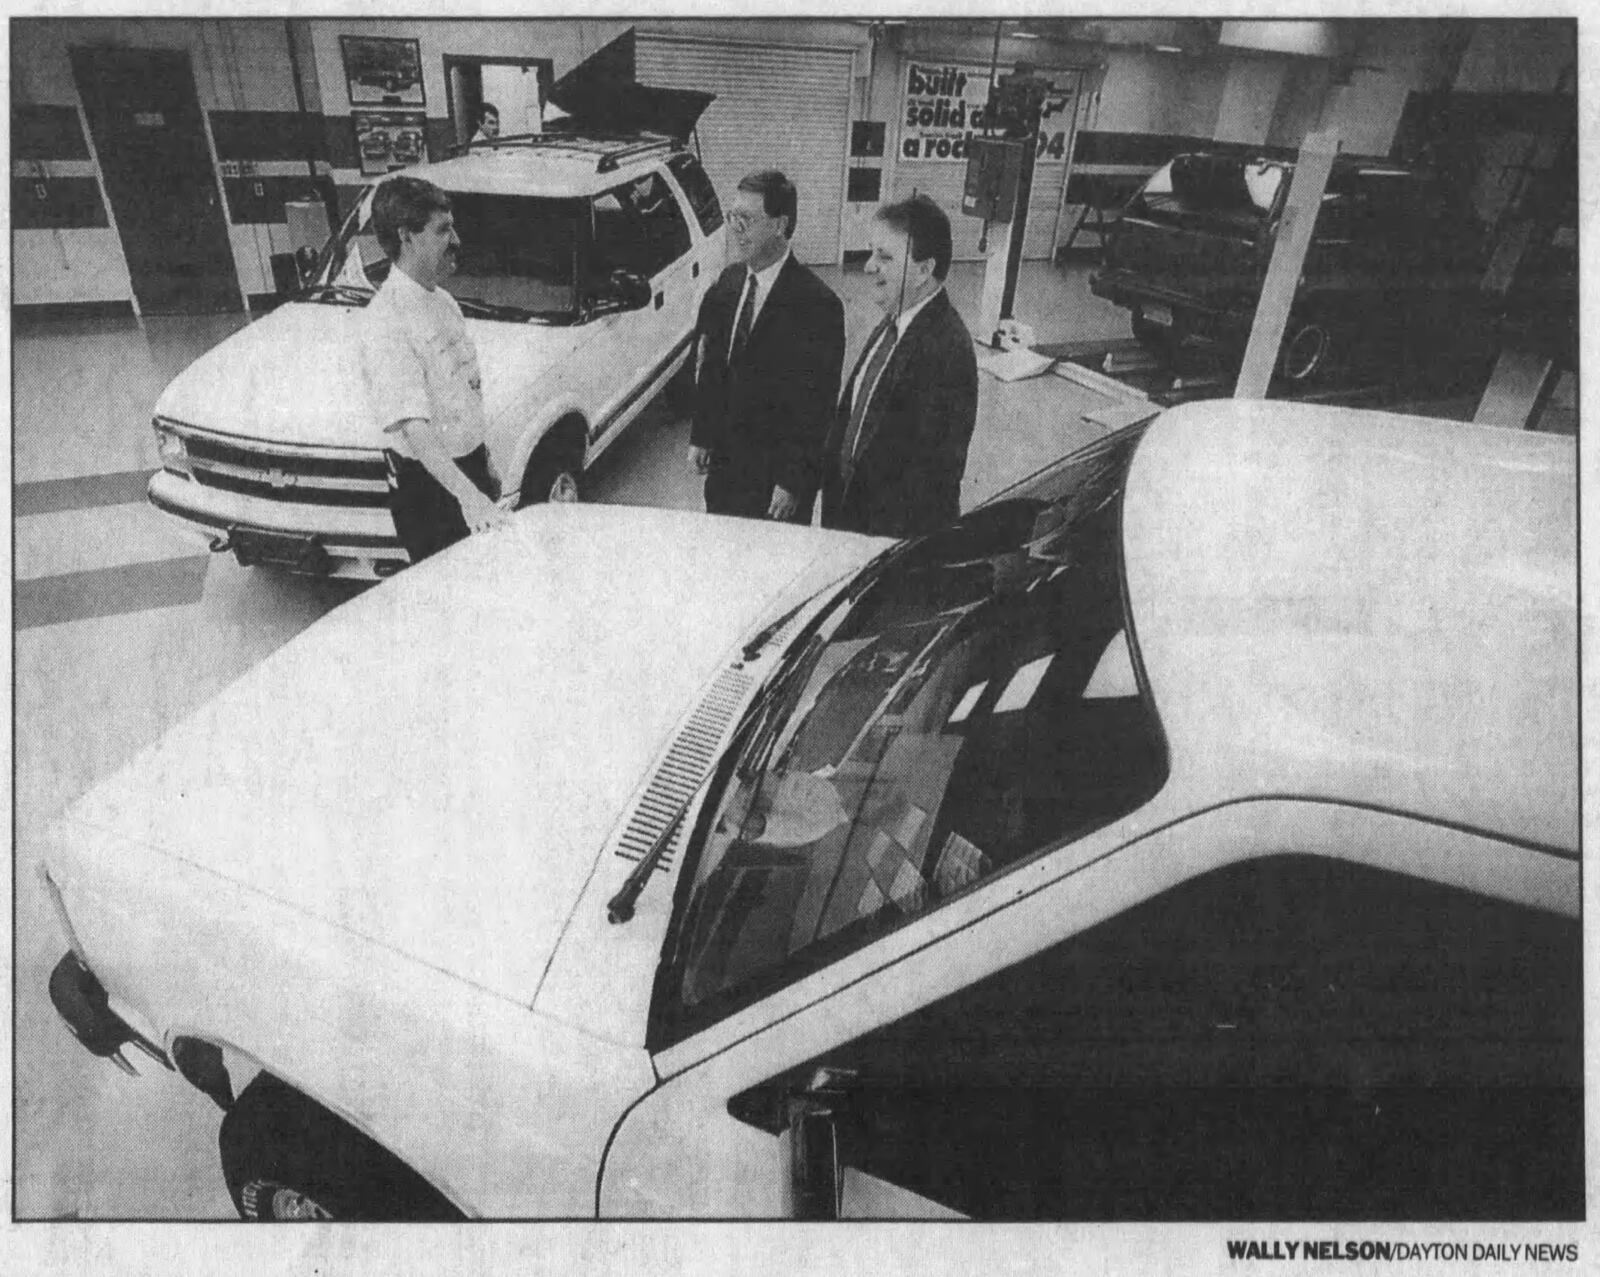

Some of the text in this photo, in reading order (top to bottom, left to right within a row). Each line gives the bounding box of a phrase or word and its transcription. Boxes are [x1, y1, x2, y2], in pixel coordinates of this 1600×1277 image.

[908, 64, 967, 97] built
[906, 98, 965, 128] solid
[902, 138, 920, 159] a
